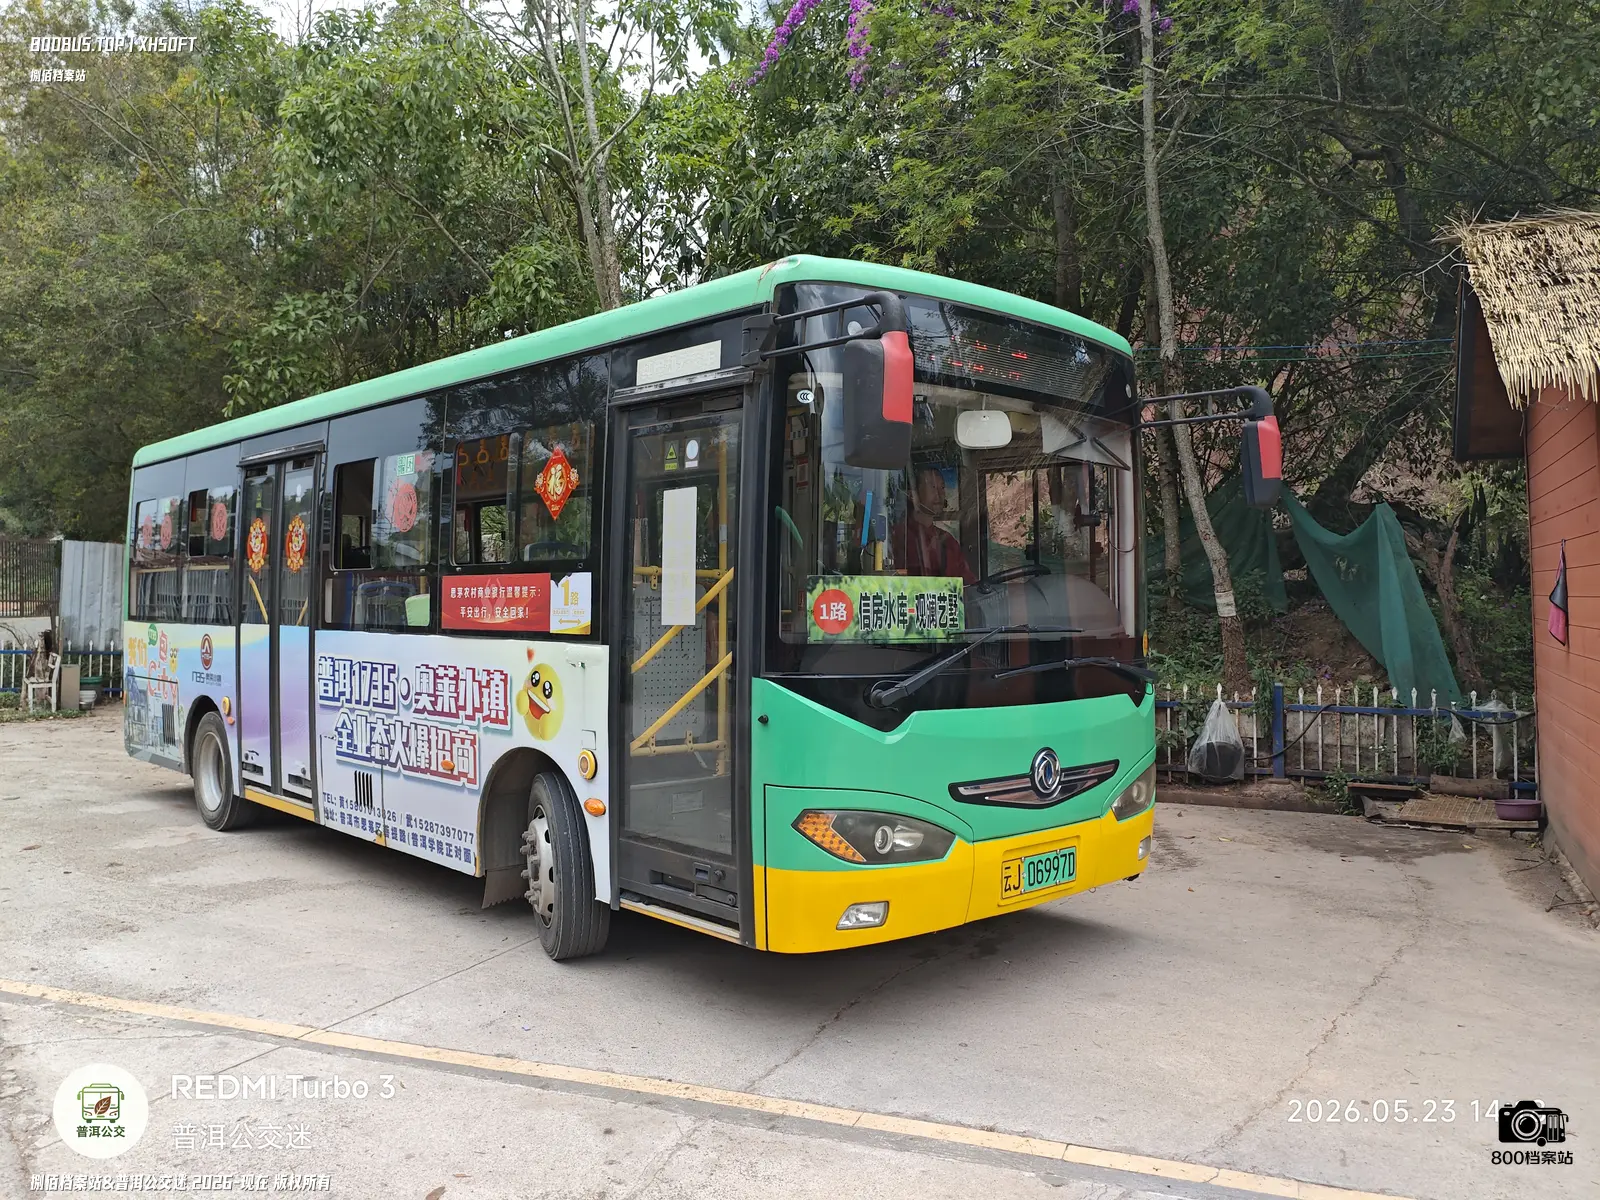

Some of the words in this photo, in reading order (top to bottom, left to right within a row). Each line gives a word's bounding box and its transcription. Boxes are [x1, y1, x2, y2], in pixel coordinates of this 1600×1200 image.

[819, 602, 847, 621] 1路
[335, 711, 478, 786] 全业态火爆招商
